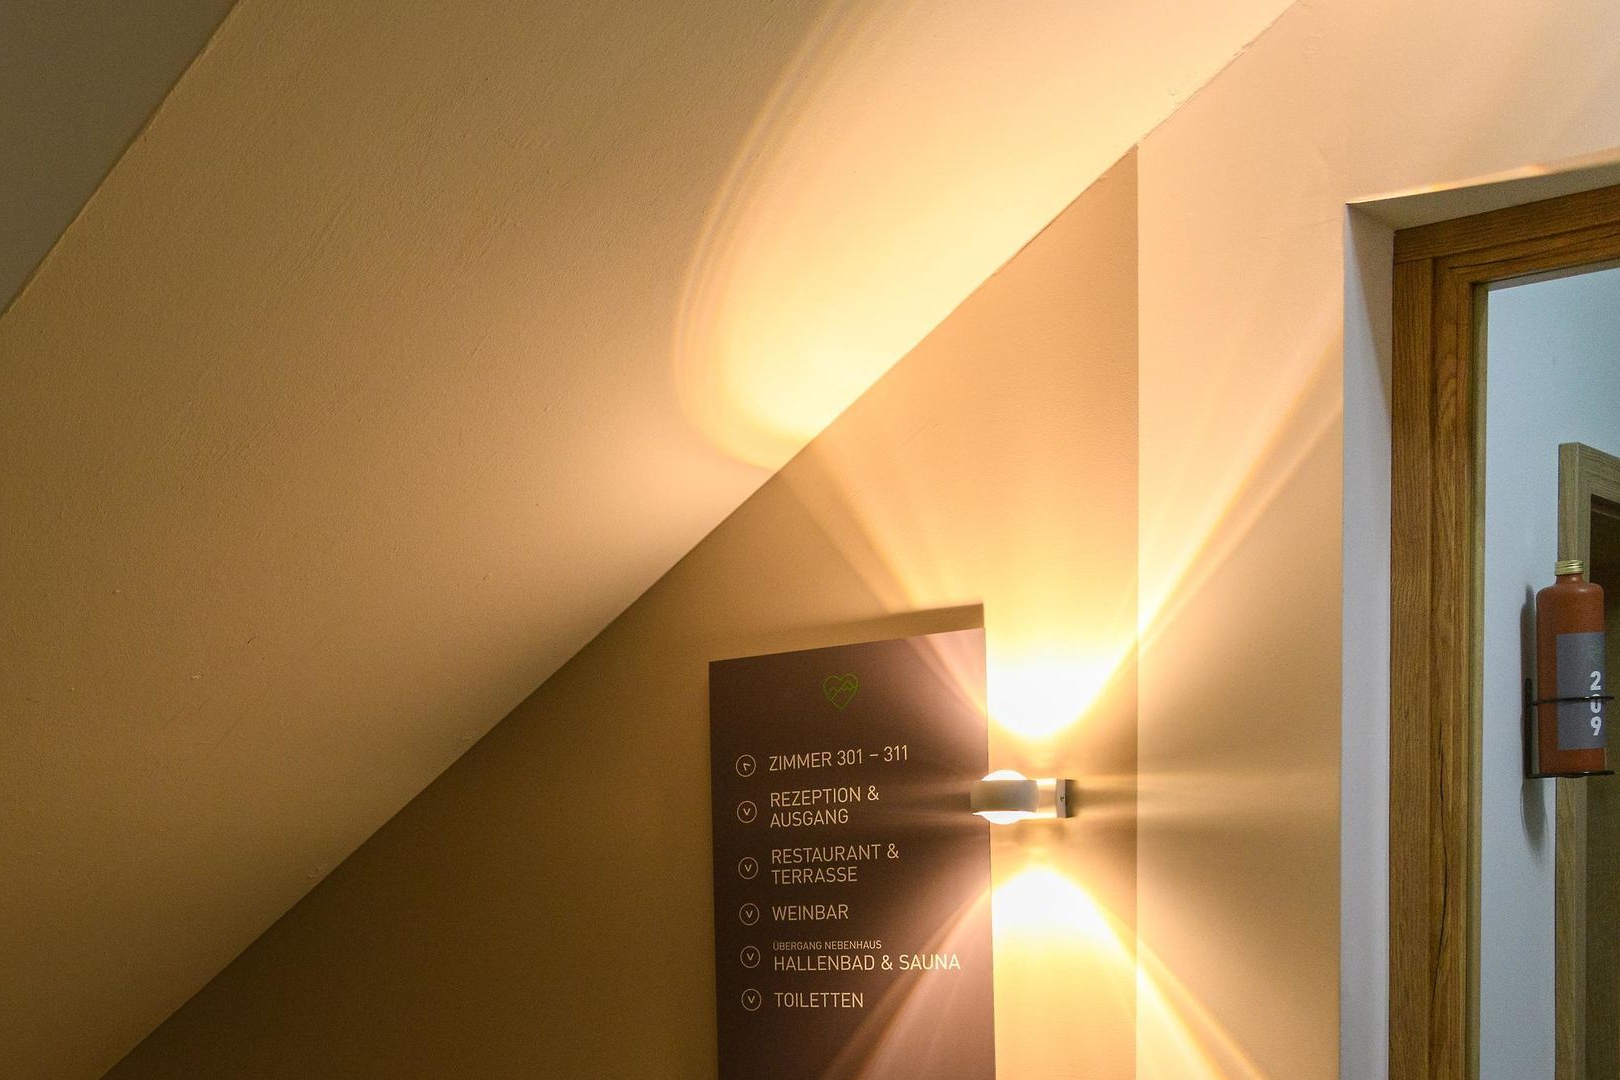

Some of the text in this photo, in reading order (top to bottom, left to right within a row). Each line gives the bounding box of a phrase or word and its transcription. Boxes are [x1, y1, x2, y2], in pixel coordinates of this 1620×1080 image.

[769, 751, 832, 771] ZIMMER
[836, 748, 863, 766] 301
[883, 744, 908, 762] 311
[770, 785, 880, 808] REZEPTION &
[770, 808, 849, 828] AUSGANG
[771, 843, 899, 864] RESTAURANT &
[771, 866, 858, 885] TERRASSE
[772, 904, 849, 921] WEINBAR
[772, 940, 882, 951] ÜBERGANG NEBENHAUS
[774, 953, 961, 971] HALLENBAD & SAUNA
[774, 992, 863, 1008] TOILETTEN
